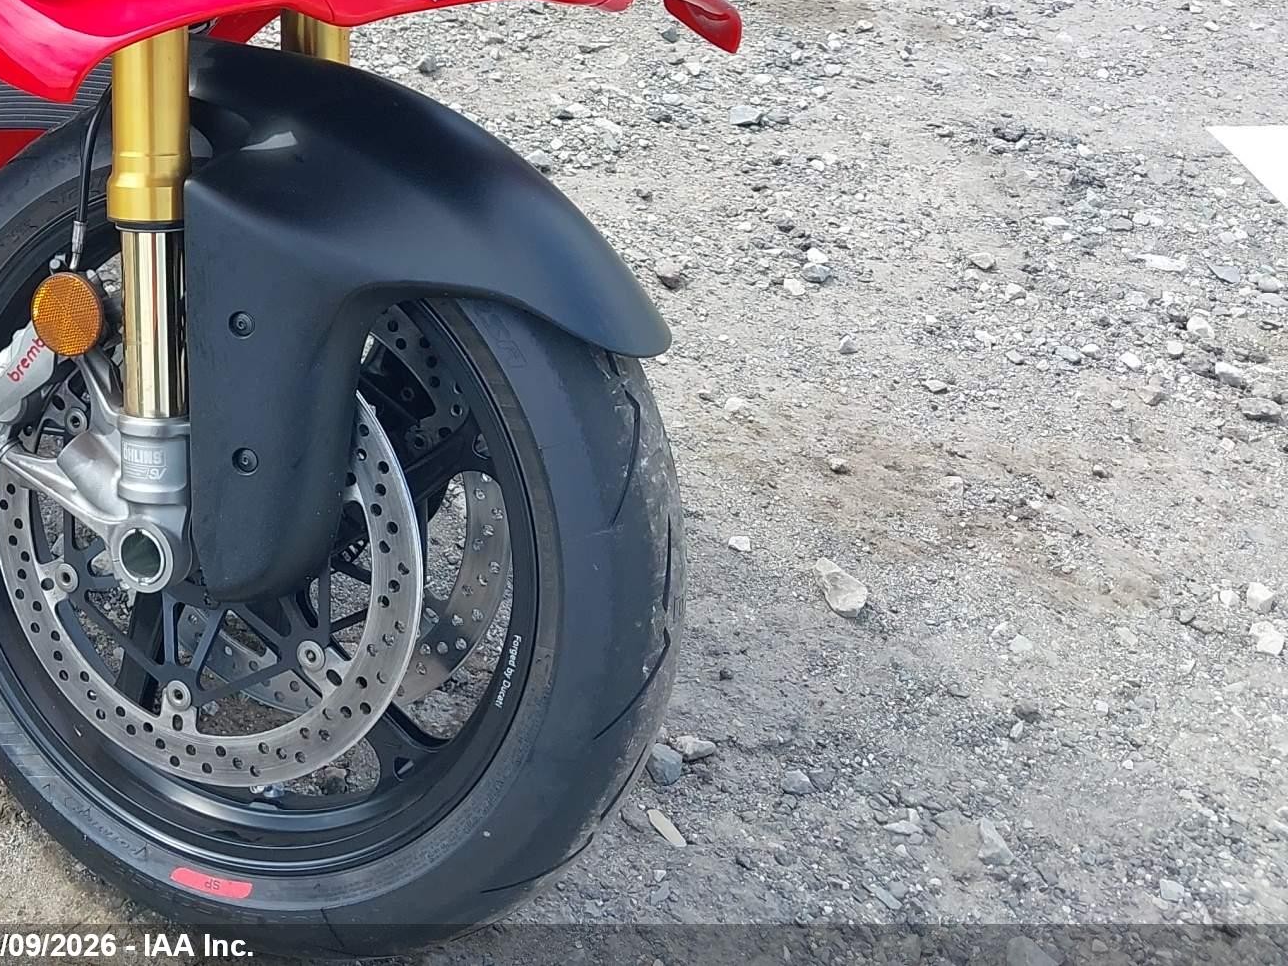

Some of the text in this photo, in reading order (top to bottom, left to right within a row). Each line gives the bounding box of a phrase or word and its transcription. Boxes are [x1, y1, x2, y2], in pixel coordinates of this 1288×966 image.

[7, 338, 45, 382] bremb
[495, 634, 522, 709] Forged by Ducati
[204, 879, 221, 891] SP
